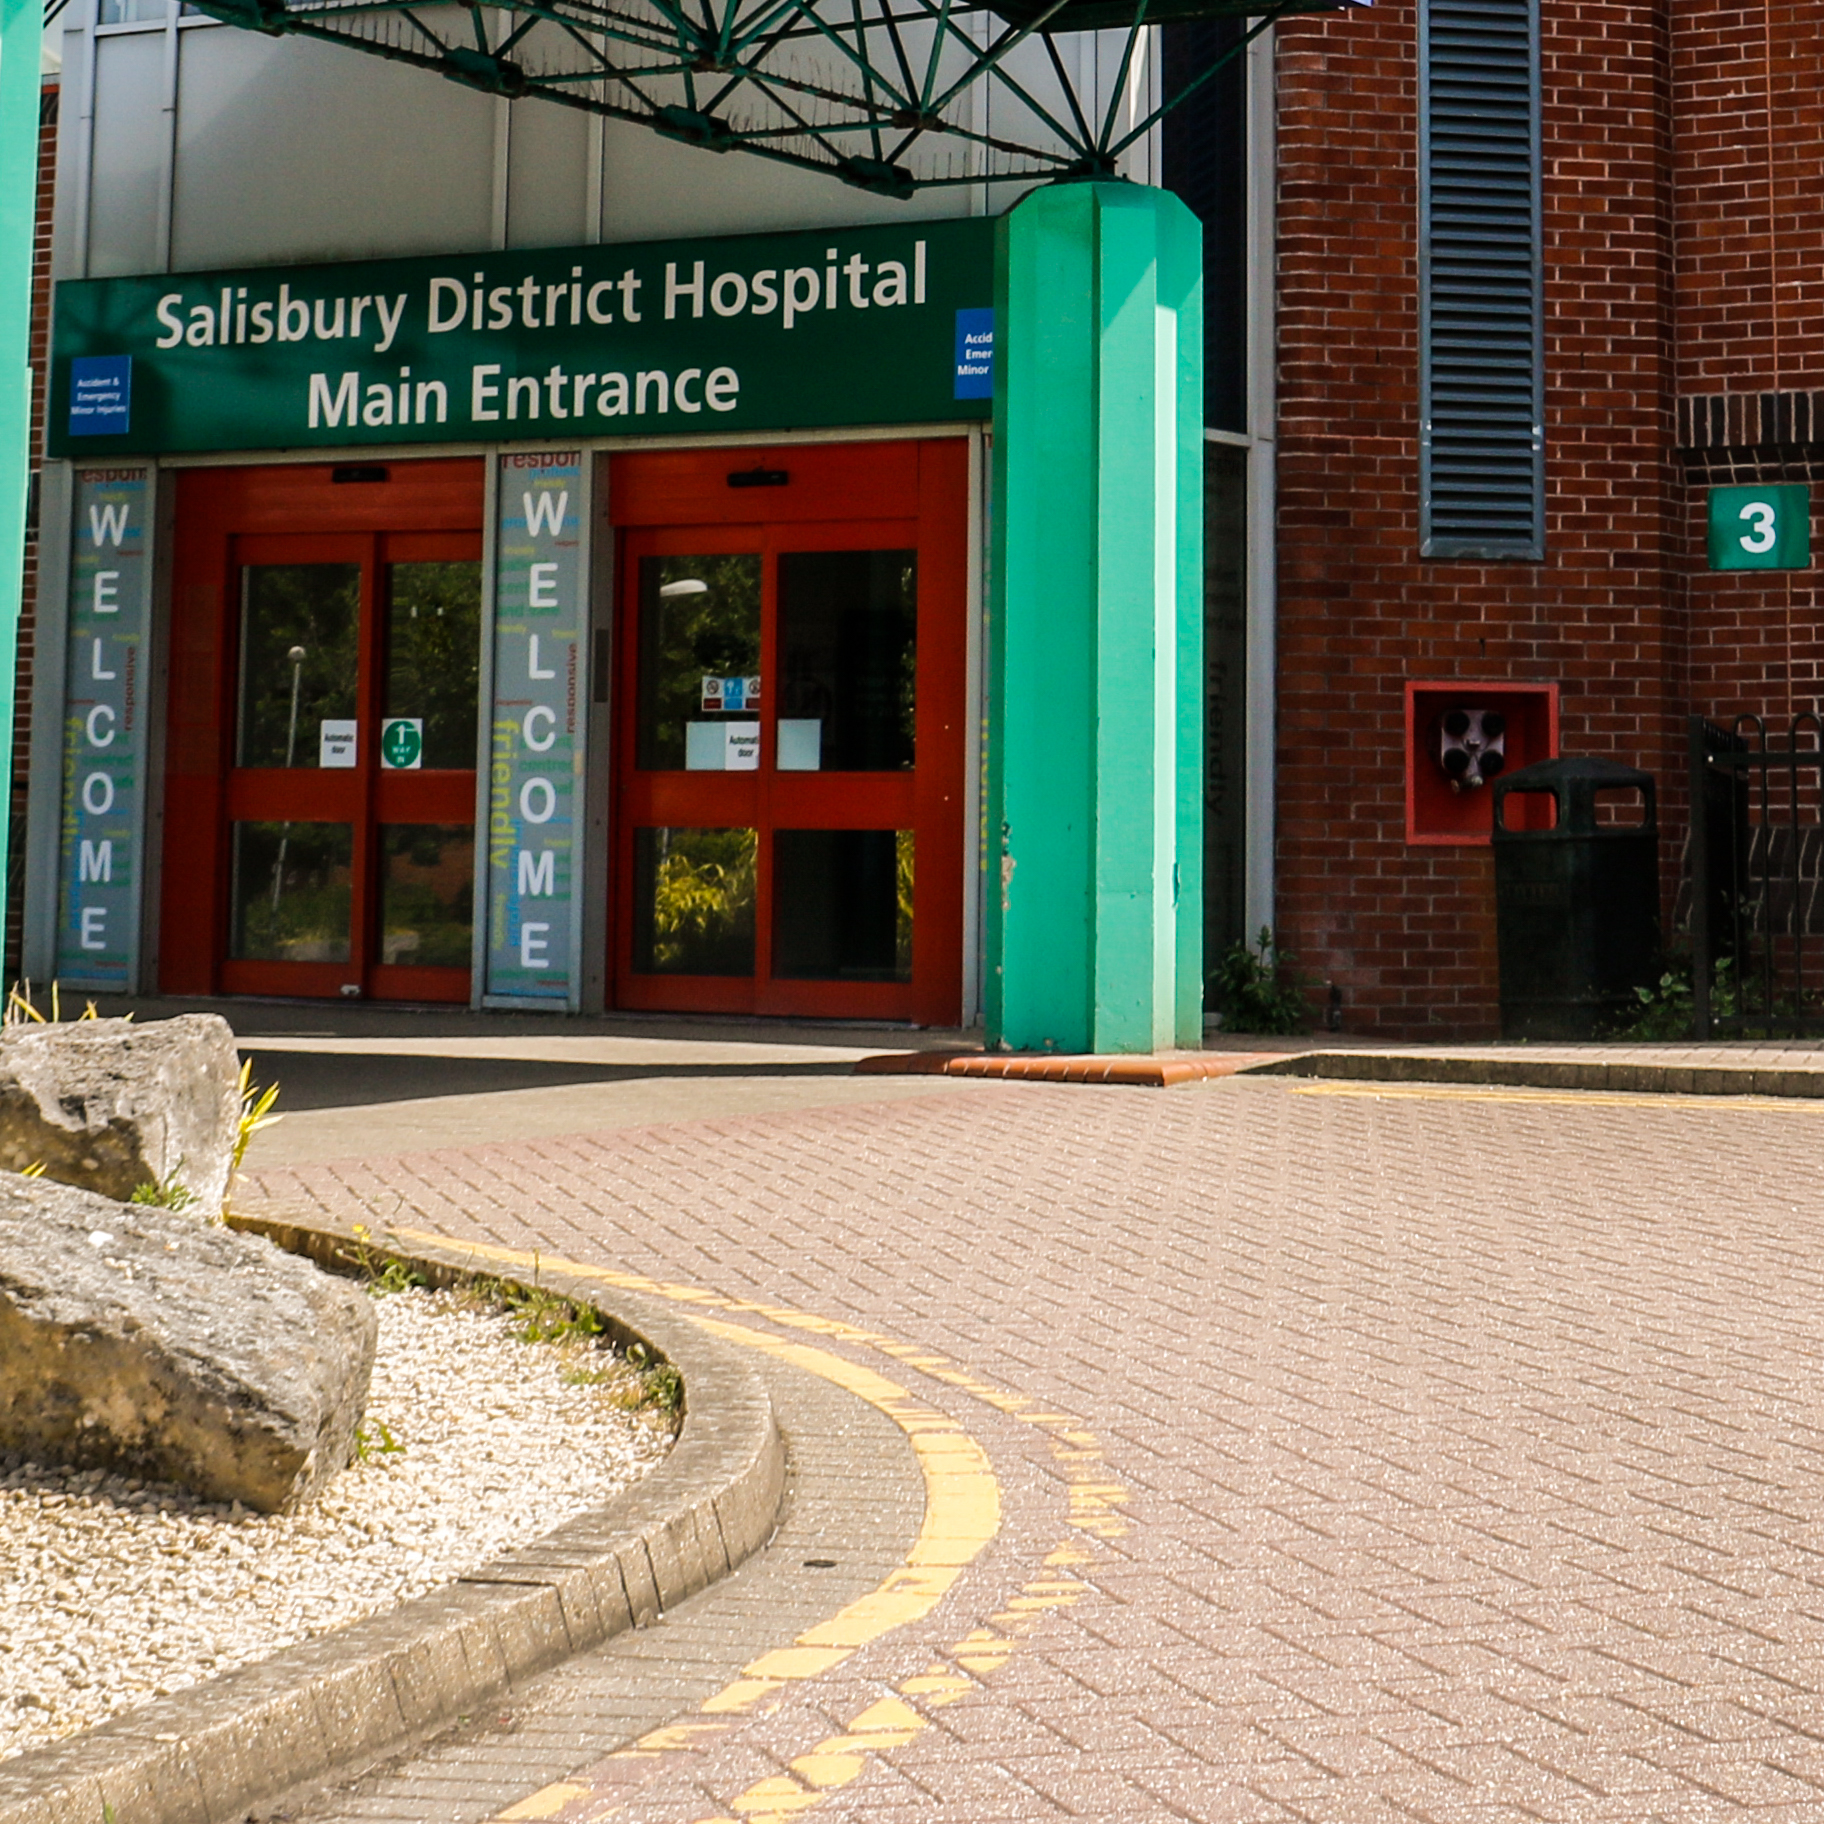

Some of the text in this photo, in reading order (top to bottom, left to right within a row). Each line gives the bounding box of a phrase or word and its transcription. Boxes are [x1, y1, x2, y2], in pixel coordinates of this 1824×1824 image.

[156, 240, 926, 352] Salisbury District Hospital
[77, 378, 111, 388] Accident
[77, 392, 121, 402] Emergency
[308, 364, 740, 428] Main Entrance
[957, 365, 989, 376] Minor
[1739, 501, 1776, 554] 3
[79, 504, 129, 950] WELCOME
[392, 746, 411, 754] WAY
[518, 491, 568, 968] WELCOME
